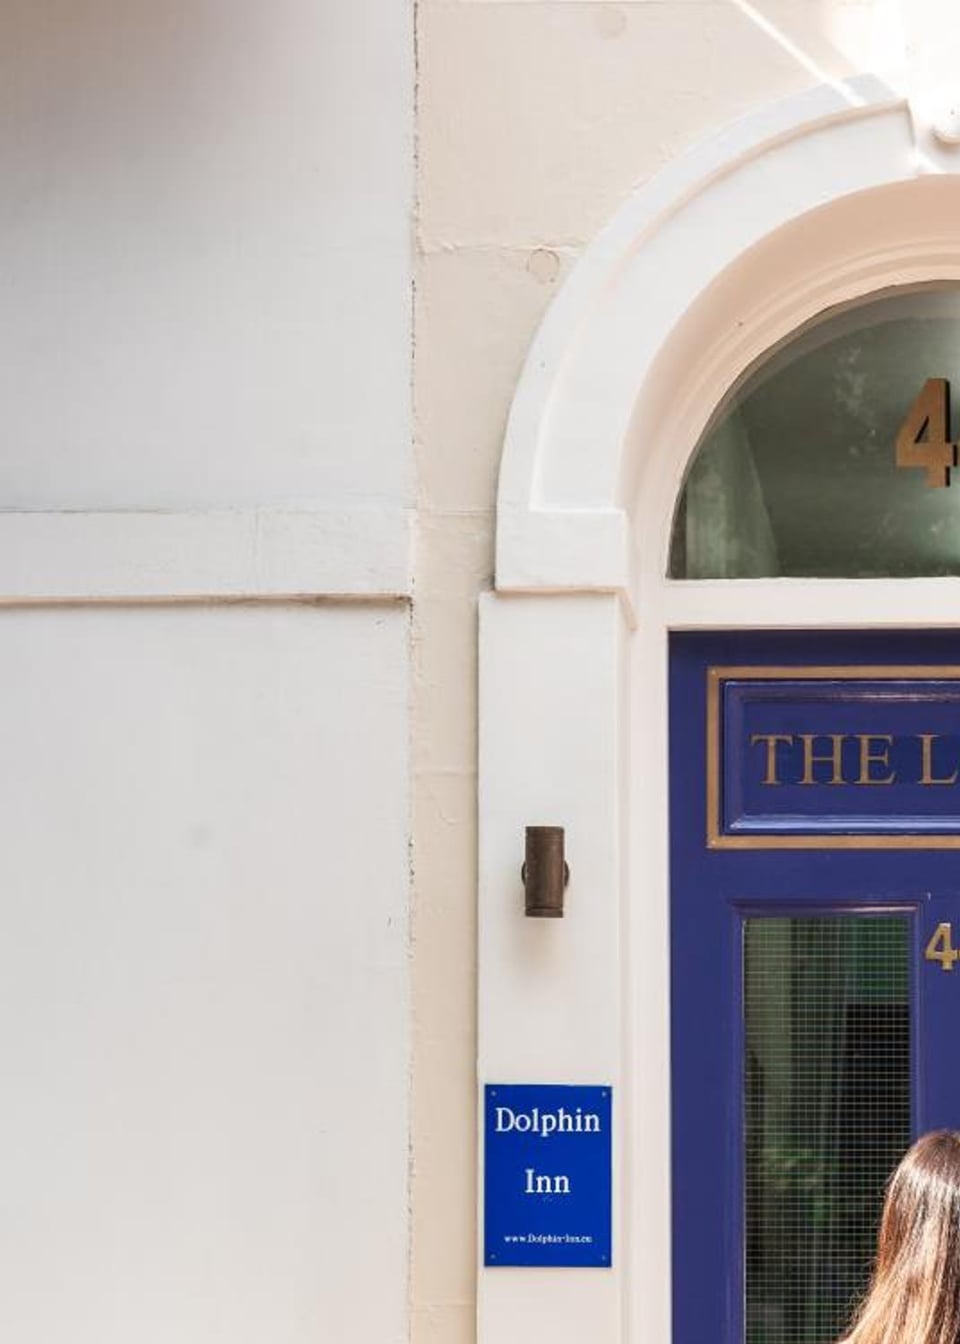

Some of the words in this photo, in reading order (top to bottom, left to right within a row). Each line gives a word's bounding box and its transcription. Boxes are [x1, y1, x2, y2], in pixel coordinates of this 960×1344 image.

[751, 734, 896, 785] THE
[496, 1107, 601, 1137] Dolphin
[525, 1168, 571, 1193] Inn
